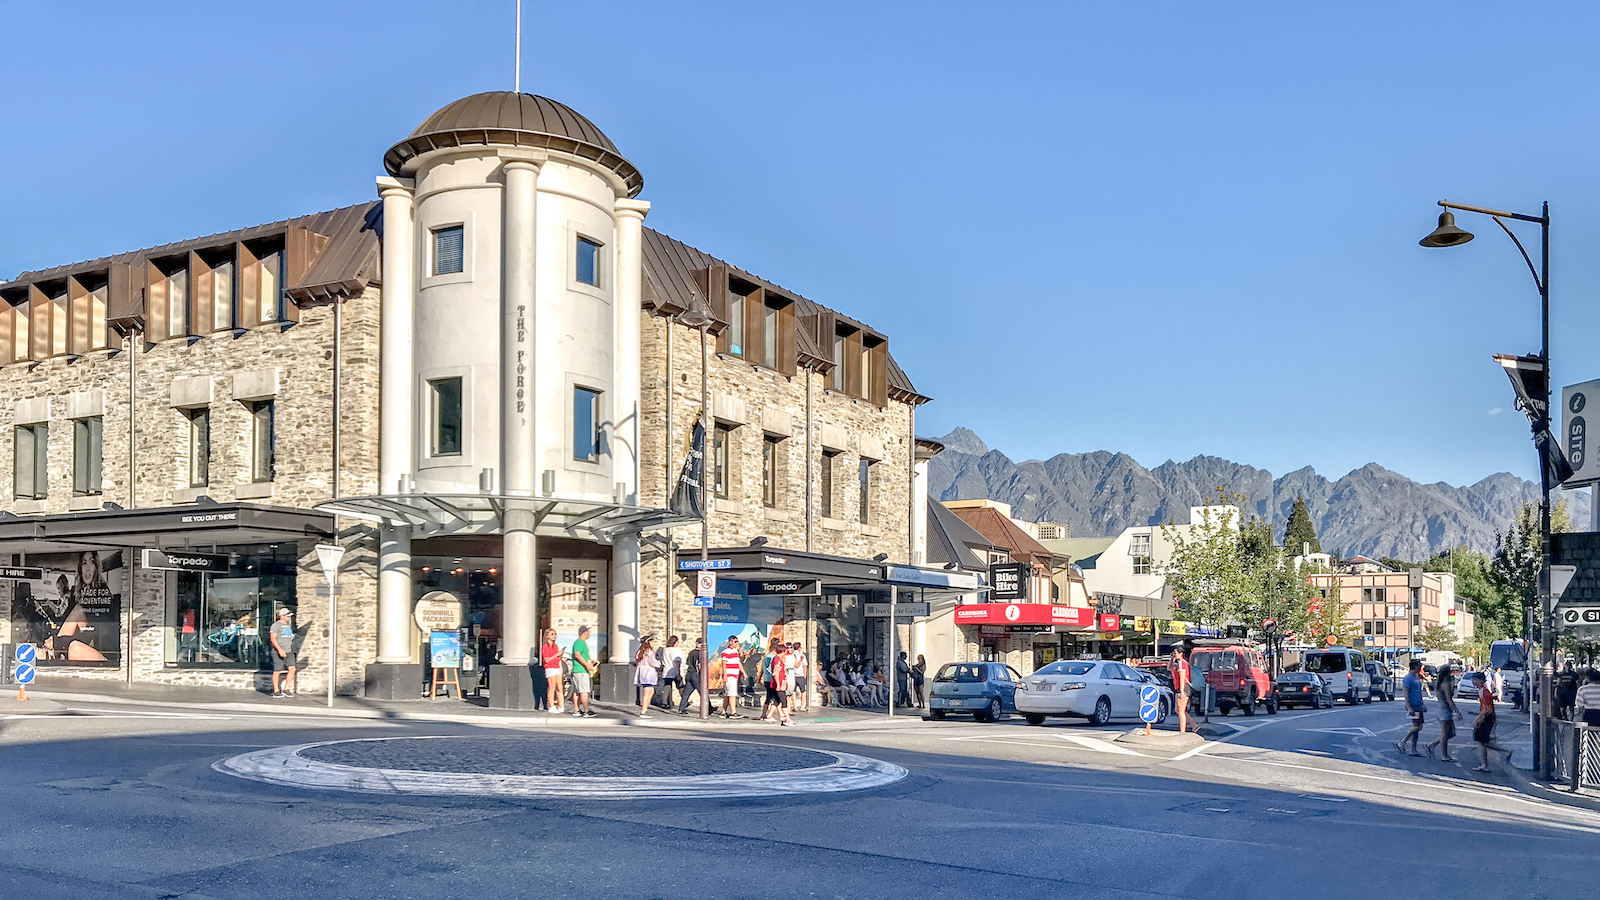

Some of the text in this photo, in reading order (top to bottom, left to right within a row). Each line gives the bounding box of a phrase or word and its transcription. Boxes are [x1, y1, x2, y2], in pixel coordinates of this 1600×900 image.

[516, 305, 525, 413] THE FORGE
[717, 560, 725, 568] ST
[6, 569, 25, 577] HIRE
[562, 569, 597, 584] BIKE
[995, 573, 1018, 582] Bike
[995, 581, 1018, 591] Hire
[562, 586, 597, 602] HIRE
[80, 597, 111, 605] ADVENTURE
[422, 609, 455, 617] DOWNHILL
